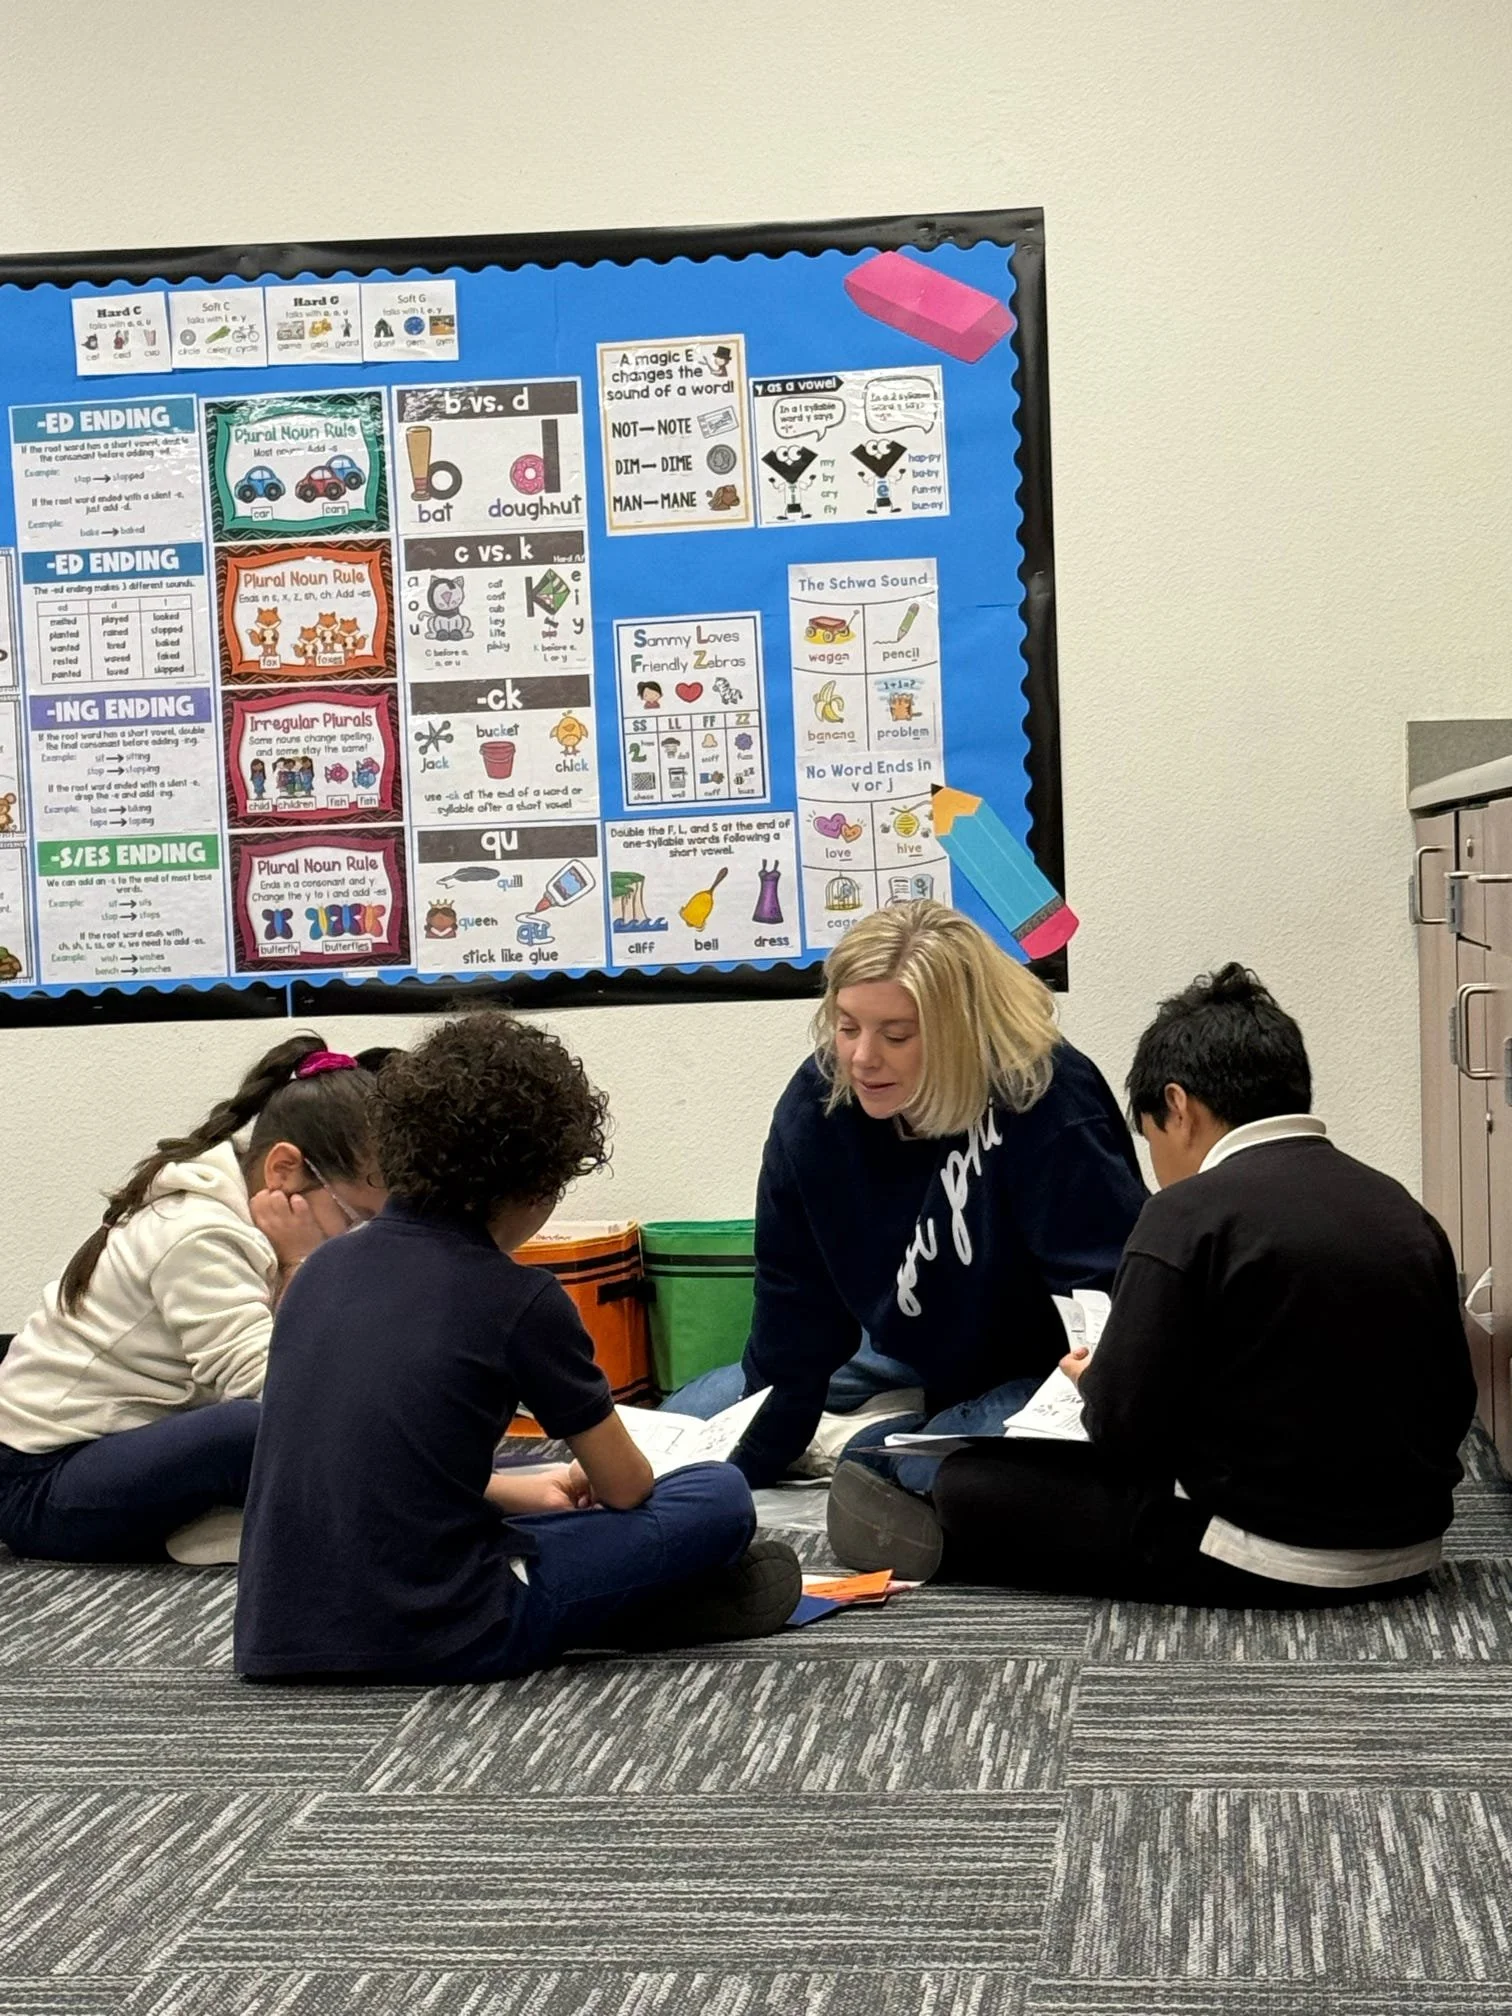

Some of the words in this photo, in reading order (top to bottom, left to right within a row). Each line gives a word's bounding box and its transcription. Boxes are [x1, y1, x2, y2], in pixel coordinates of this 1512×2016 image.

[223, 302, 231, 312] C
[294, 297, 327, 307] Hard
[397, 294, 416, 304] Soft
[418, 294, 427, 303] G
[97, 308, 131, 319] Hard
[133, 306, 143, 316] C
[619, 353, 631, 367] A
[635, 353, 680, 366] magic
[685, 349, 694, 365] E
[612, 368, 673, 383] changes
[678, 366, 703, 379] the
[607, 385, 649, 401] sound
[654, 384, 672, 397] of
[677, 386, 687, 396] a
[767, 381, 783, 394] as
[786, 381, 795, 393] a
[800, 376, 837, 392] vowel
[444, 391, 461, 414] b
[468, 394, 504, 413] vs.
[512, 387, 530, 411] d
[37, 412, 75, 434] -ED
[80, 406, 171, 432] ENDING
[234, 426, 276, 444] Plural
[281, 424, 320, 440] Noun
[325, 422, 357, 438] Rule
[612, 421, 638, 439] NOT
[658, 418, 692, 435] NOTE
[615, 459, 640, 475] DIM
[661, 455, 693, 472] DIME
[325, 503, 347, 515] cars
[488, 495, 582, 521] doughnut
[613, 494, 642, 512] MAN
[661, 491, 697, 509] MANE
[254, 509, 271, 519] car
[418, 503, 453, 523] bat
[454, 546, 469, 563] c
[478, 545, 512, 562] vs.
[519, 536, 534, 560] k
[46, 554, 84, 576] -ED
[89, 548, 180, 573] ENDING
[244, 572, 286, 589] Plural
[290, 571, 328, 586] Noun
[333, 569, 366, 584] Rule
[408, 576, 419, 588] a
[571, 570, 582, 582] e
[799, 578, 825, 592] The
[829, 576, 876, 590] Schwa
[881, 573, 928, 588] Sound
[408, 601, 419, 611] o
[409, 624, 420, 635] u
[572, 618, 584, 635] y
[634, 629, 691, 648] Sammy
[696, 625, 740, 645] Loves
[630, 654, 689, 674] Friendly
[693, 650, 747, 670] Zebras
[808, 652, 850, 665] wagon
[882, 647, 920, 661] pencil
[477, 679, 523, 711] -ck
[46, 700, 100, 722] -ING
[105, 696, 195, 719] ENDING
[250, 715, 319, 733] Irregular
[323, 712, 373, 729] Plurals
[702, 715, 716, 728] FF
[476, 724, 520, 738] bucket
[808, 729, 856, 742] banana
[876, 727, 930, 741] problem
[420, 757, 450, 773] jack
[555, 759, 590, 773] chick
[806, 764, 826, 779] No
[831, 762, 873, 777] Word
[877, 758, 914, 774] Ends
[424, 793, 442, 802] use
[463, 790, 473, 799] at
[478, 788, 493, 799] the
[497, 787, 515, 798] end
[517, 786, 529, 798] of
[533, 788, 540, 796] a
[543, 786, 568, 796] word
[865, 780, 884, 792] or
[248, 801, 270, 811] child
[278, 798, 314, 810] children
[330, 797, 347, 807] fish
[359, 796, 376, 806] fish
[437, 801, 474, 817] syllable
[478, 801, 503, 813] after
[506, 803, 513, 811] a
[517, 799, 541, 811] short
[545, 799, 572, 810] vowel
[611, 825, 645, 839] Double
[648, 823, 665, 835] the
[690, 823, 710, 834] and
[712, 823, 718, 833] S
[721, 821, 732, 832] at
[736, 820, 753, 831] the
[756, 819, 776, 830] end
[778, 818, 791, 829] of
[480, 830, 519, 860] qu
[622, 834, 684, 848] one-syllable
[687, 834, 720, 846] words
[723, 830, 770, 844] following
[773, 832, 780, 841] a
[50, 846, 112, 869] -S/ES
[116, 841, 207, 866] ENDING
[669, 845, 697, 858] short
[825, 847, 852, 859] love
[897, 843, 922, 855] hive
[257, 860, 299, 876] Plural
[304, 857, 341, 873] Noun
[347, 856, 379, 871] Rule
[260, 880, 280, 890] Ends
[283, 879, 291, 888] in
[301, 877, 346, 889] consonant
[349, 876, 366, 886] and
[497, 874, 524, 891] quill
[252, 891, 285, 904] Change
[288, 890, 301, 900] the
[314, 889, 323, 899] to
[332, 888, 349, 898] and
[353, 887, 370, 897] add
[459, 917, 498, 932] queen
[260, 943, 299, 956] butterfly
[324, 940, 370, 953] butterflies
[627, 941, 656, 954] cliff
[694, 938, 719, 952] bell
[754, 935, 790, 949] dress
[462, 948, 496, 964] stick
[501, 947, 523, 963] like
[529, 948, 559, 965] glue
